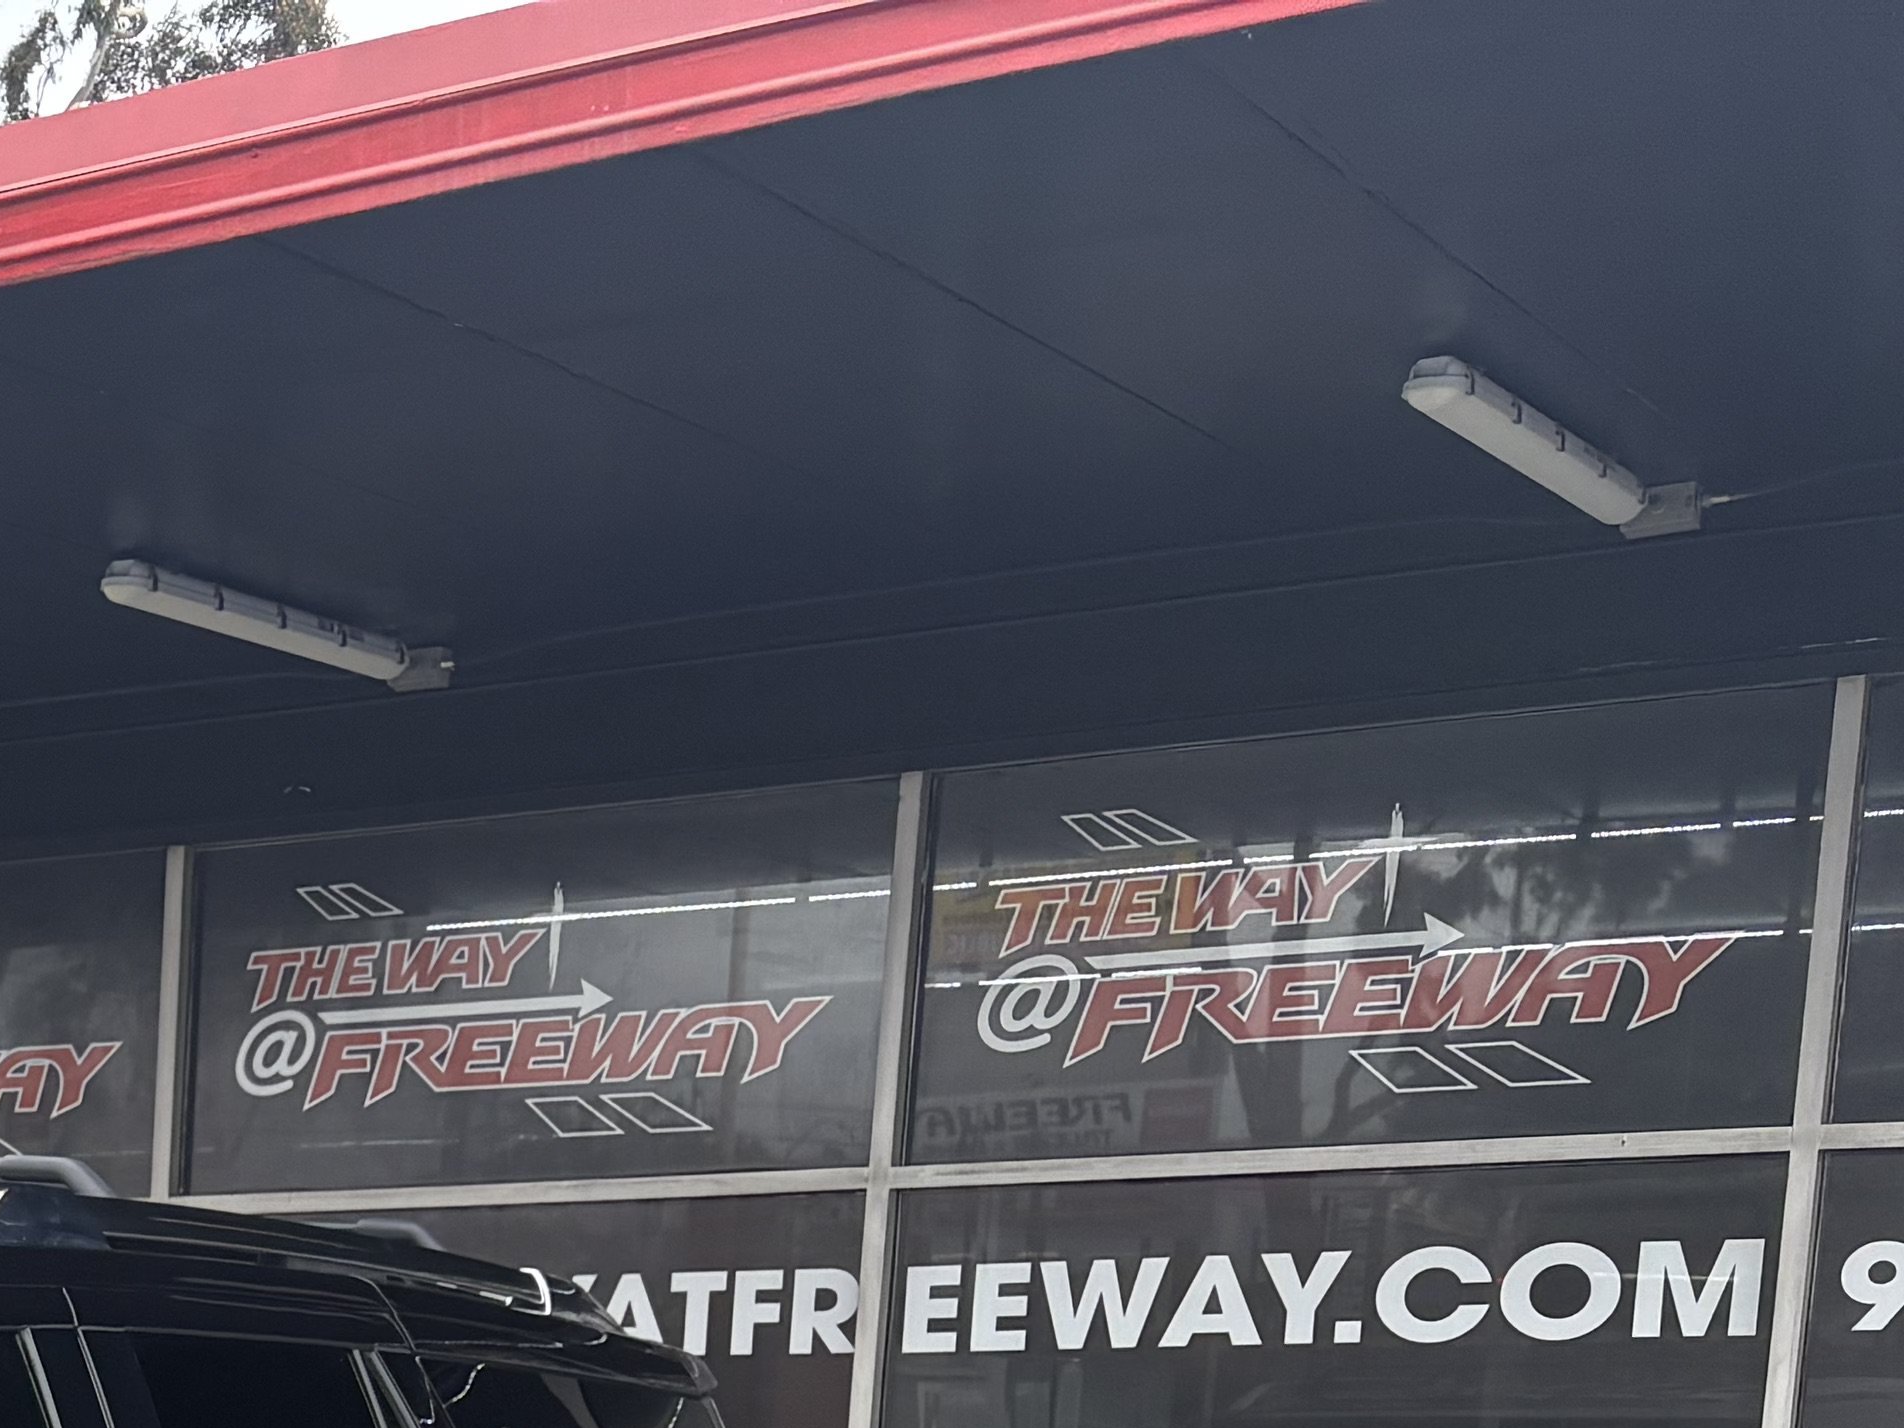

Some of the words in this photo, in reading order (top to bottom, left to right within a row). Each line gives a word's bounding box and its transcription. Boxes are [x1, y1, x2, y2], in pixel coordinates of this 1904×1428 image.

[993, 880, 1168, 957] THE
[1170, 856, 1385, 934] WAY
[247, 941, 380, 1013] THE
[383, 928, 547, 993] WAY
[977, 931, 1746, 1068] @FREEWAY
[235, 996, 834, 1111] @FREEWAY
[572, 1239, 1765, 1356] ATFREEWAY.COM
